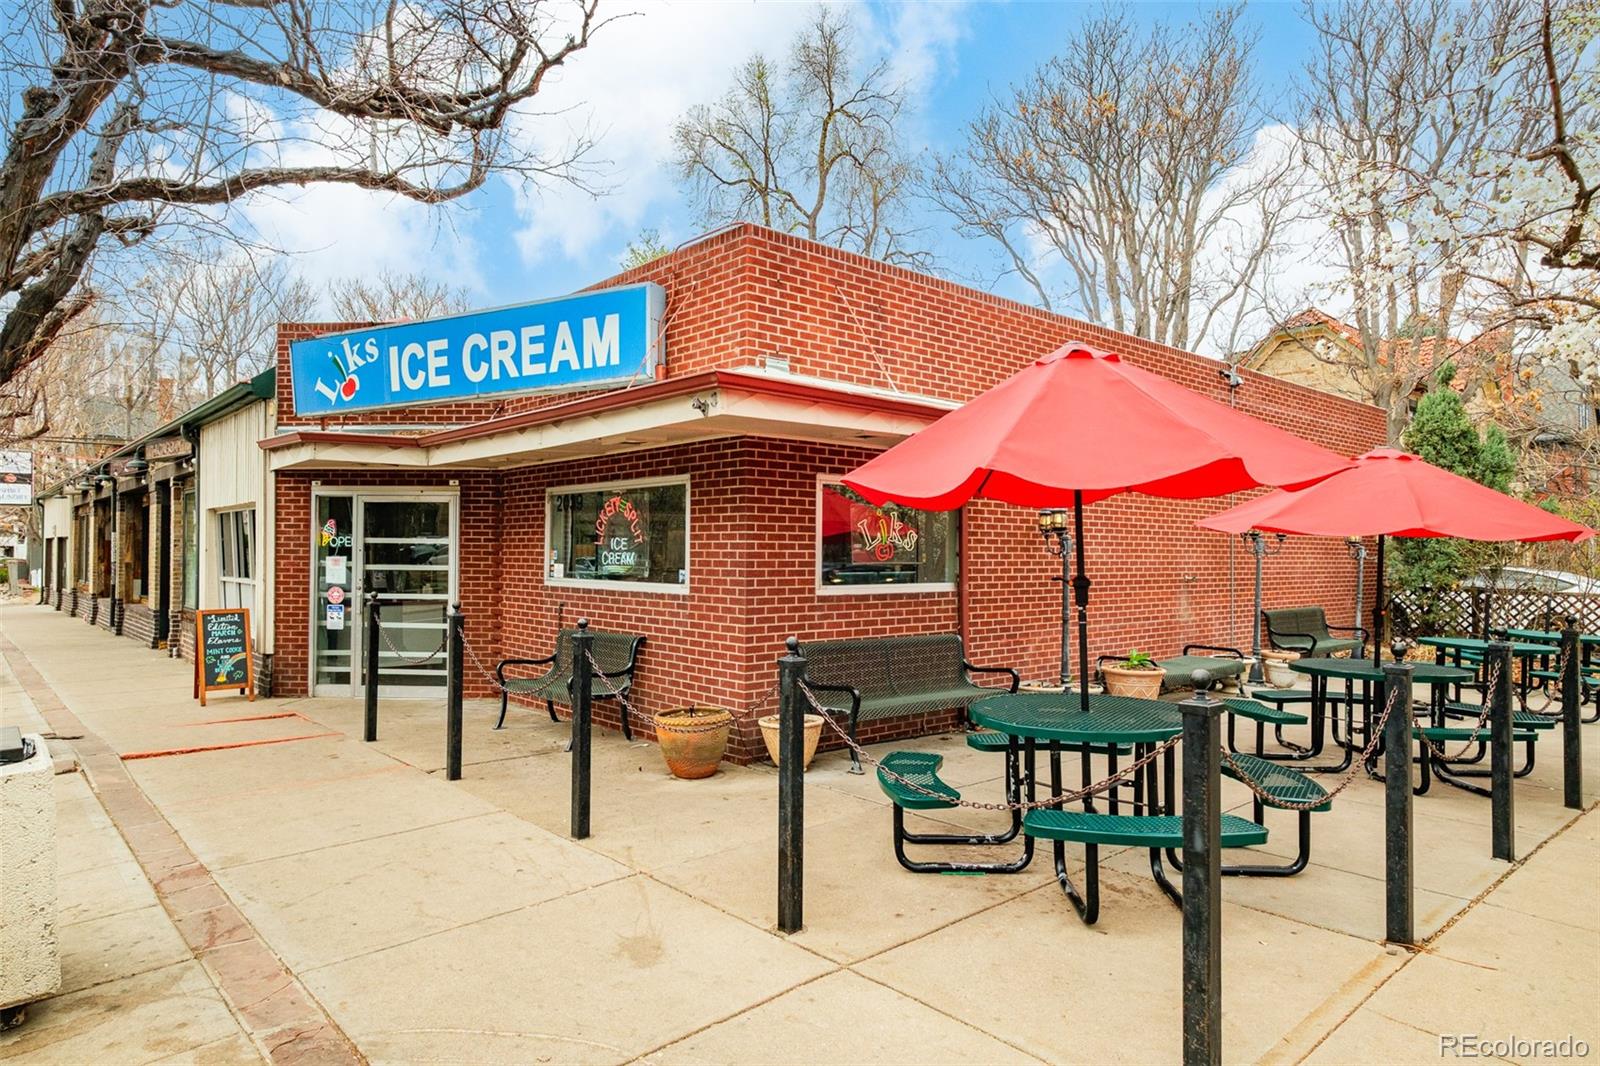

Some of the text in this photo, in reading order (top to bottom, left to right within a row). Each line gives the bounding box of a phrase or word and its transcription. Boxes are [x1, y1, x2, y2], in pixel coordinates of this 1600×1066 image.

[389, 313, 621, 392] ICE CREAM
[330, 536, 352, 547] OPE
[610, 537, 629, 550] ICE
[601, 551, 636, 565] CREAM
